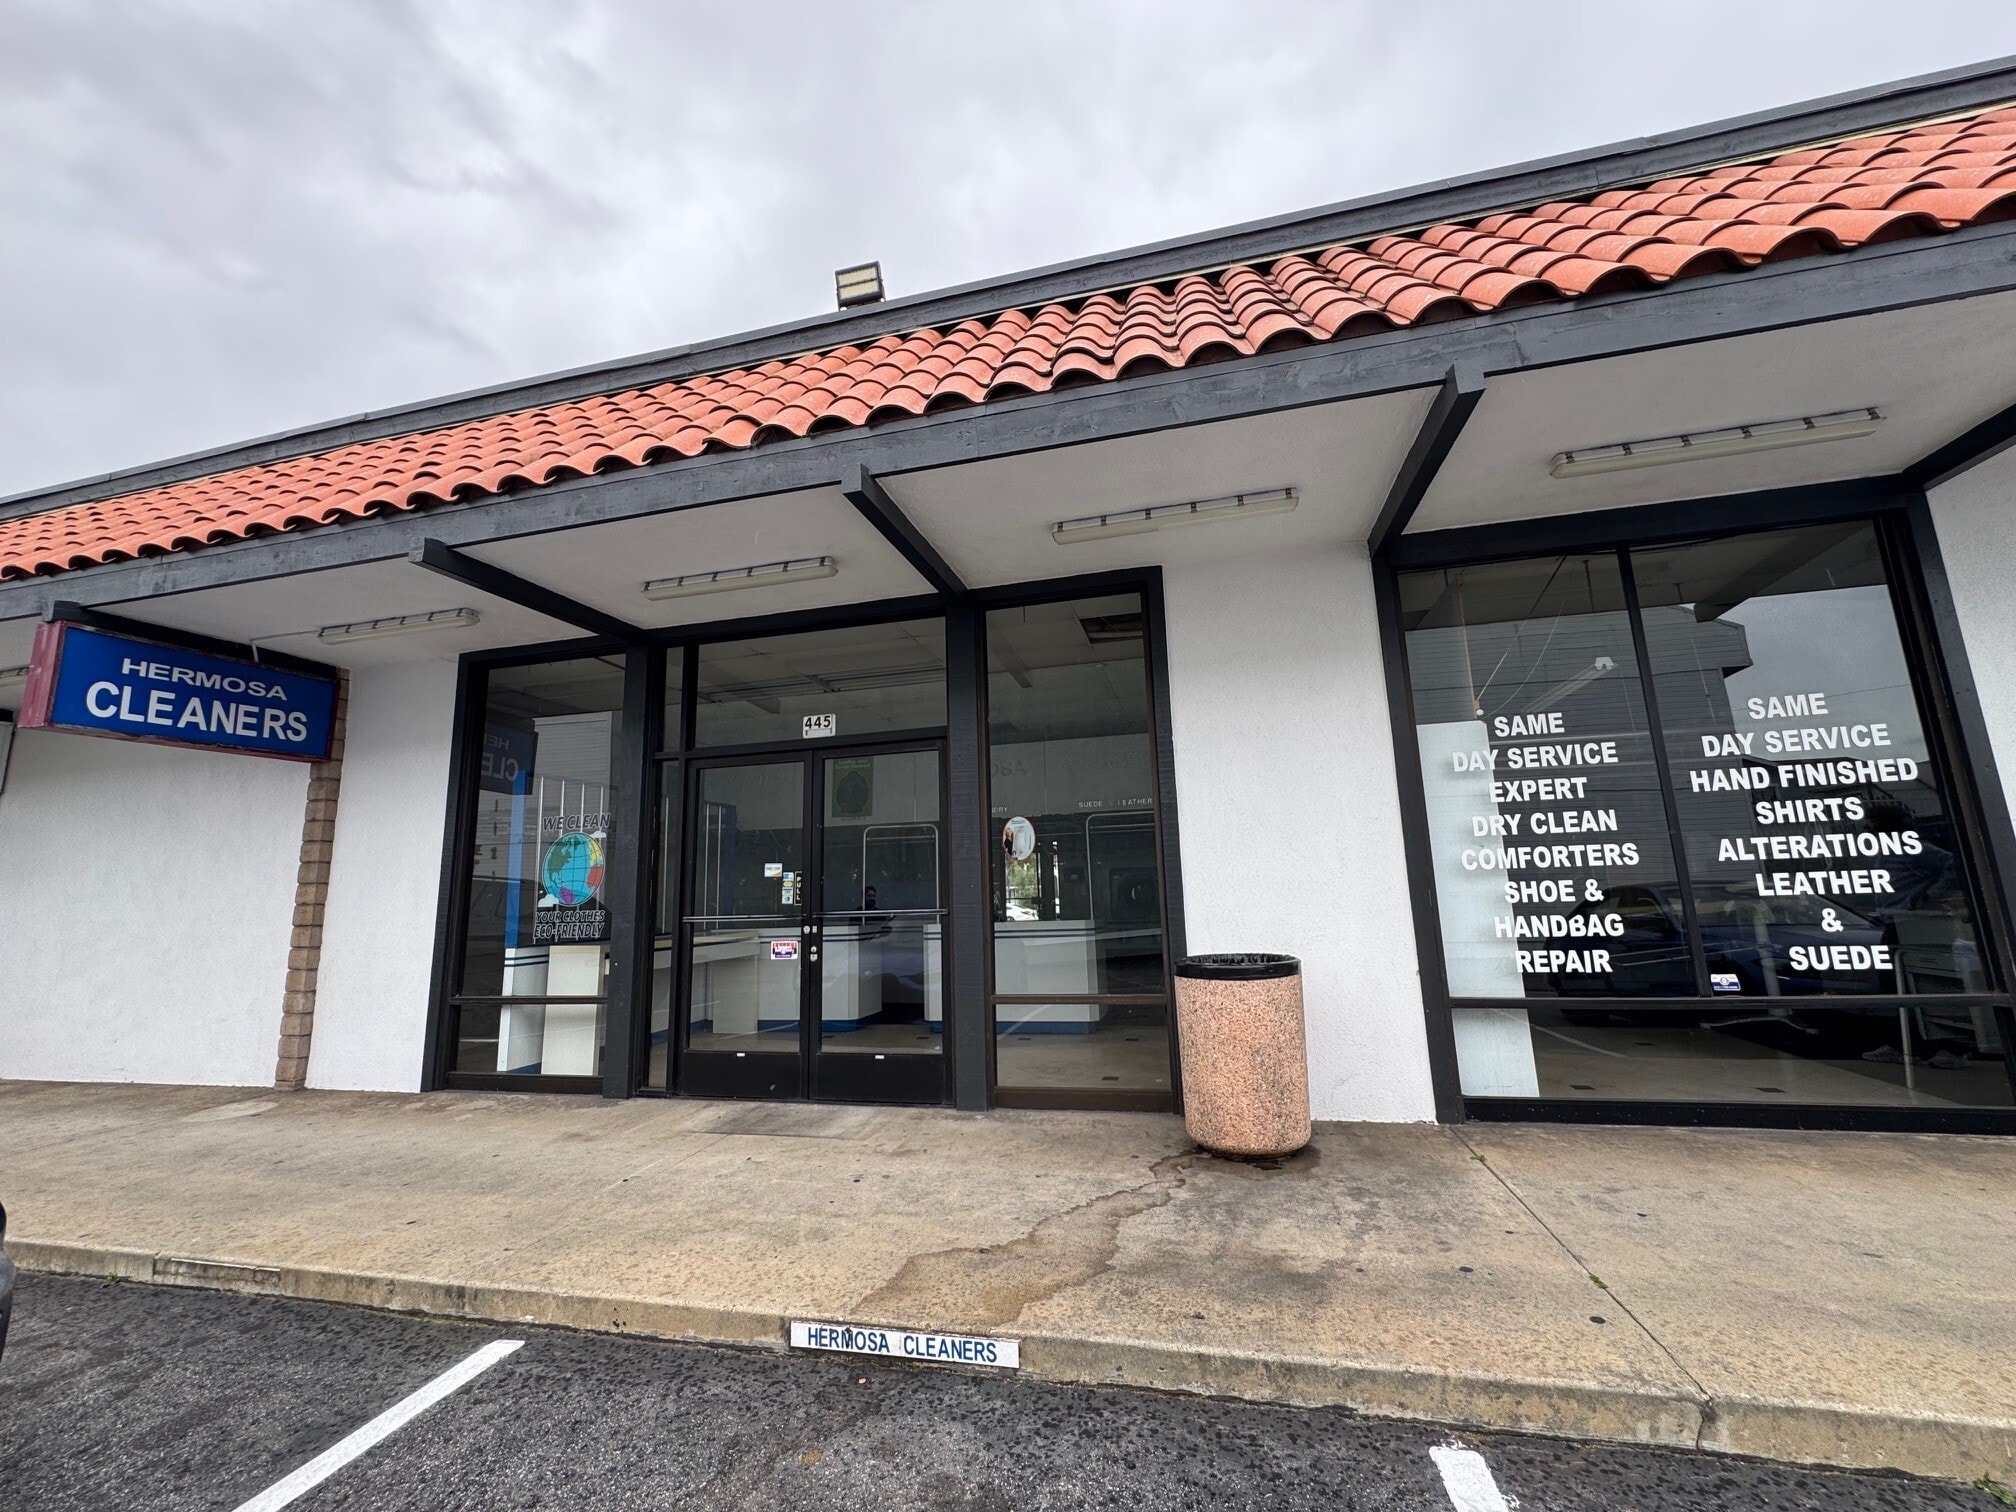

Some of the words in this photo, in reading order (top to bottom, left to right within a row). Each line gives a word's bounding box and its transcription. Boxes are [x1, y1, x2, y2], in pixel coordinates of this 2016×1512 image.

[121, 658, 287, 700] HERMOSA
[86, 681, 308, 742] CLEANERS
[1747, 692, 1828, 719] SAME
[805, 715, 831, 729] 445
[1494, 712, 1565, 738] SAME
[1701, 732, 1754, 757] DAY
[1765, 723, 1892, 753] SERVICE
[1452, 749, 1499, 772] DAY
[1507, 741, 1619, 769] SERVICE
[1689, 766, 1770, 792] HAND
[1777, 757, 1918, 788] FINISHED
[1078, 800, 1103, 808] SUEDE
[1117, 797, 1153, 806] LEATHER
[1488, 776, 1587, 803] EXPERT
[543, 815, 565, 831] WE
[566, 812, 611, 830] CLEAN
[1472, 813, 1521, 837] DRY
[1530, 809, 1618, 835] CLEAN
[1755, 796, 1864, 824] SHIRTS
[1461, 842, 1640, 871] COMFORTERS
[1718, 830, 1923, 861] ALTERATIONS
[1504, 879, 1576, 904] SHOE
[1584, 878, 1604, 902] &
[1755, 869, 1895, 896] LEATHER
[536, 910, 562, 923] YOUR
[562, 909, 606, 922] CLOTHES
[1494, 912, 1625, 938] HANDBAG
[1820, 907, 1844, 933] &
[534, 922, 605, 938] ECO-FRIENDLY
[1514, 949, 1613, 974] REPAIR
[1788, 945, 1893, 971] SUEDE
[807, 1326, 890, 1353] HERMOSA
[903, 1334, 998, 1363] CLEANERS
